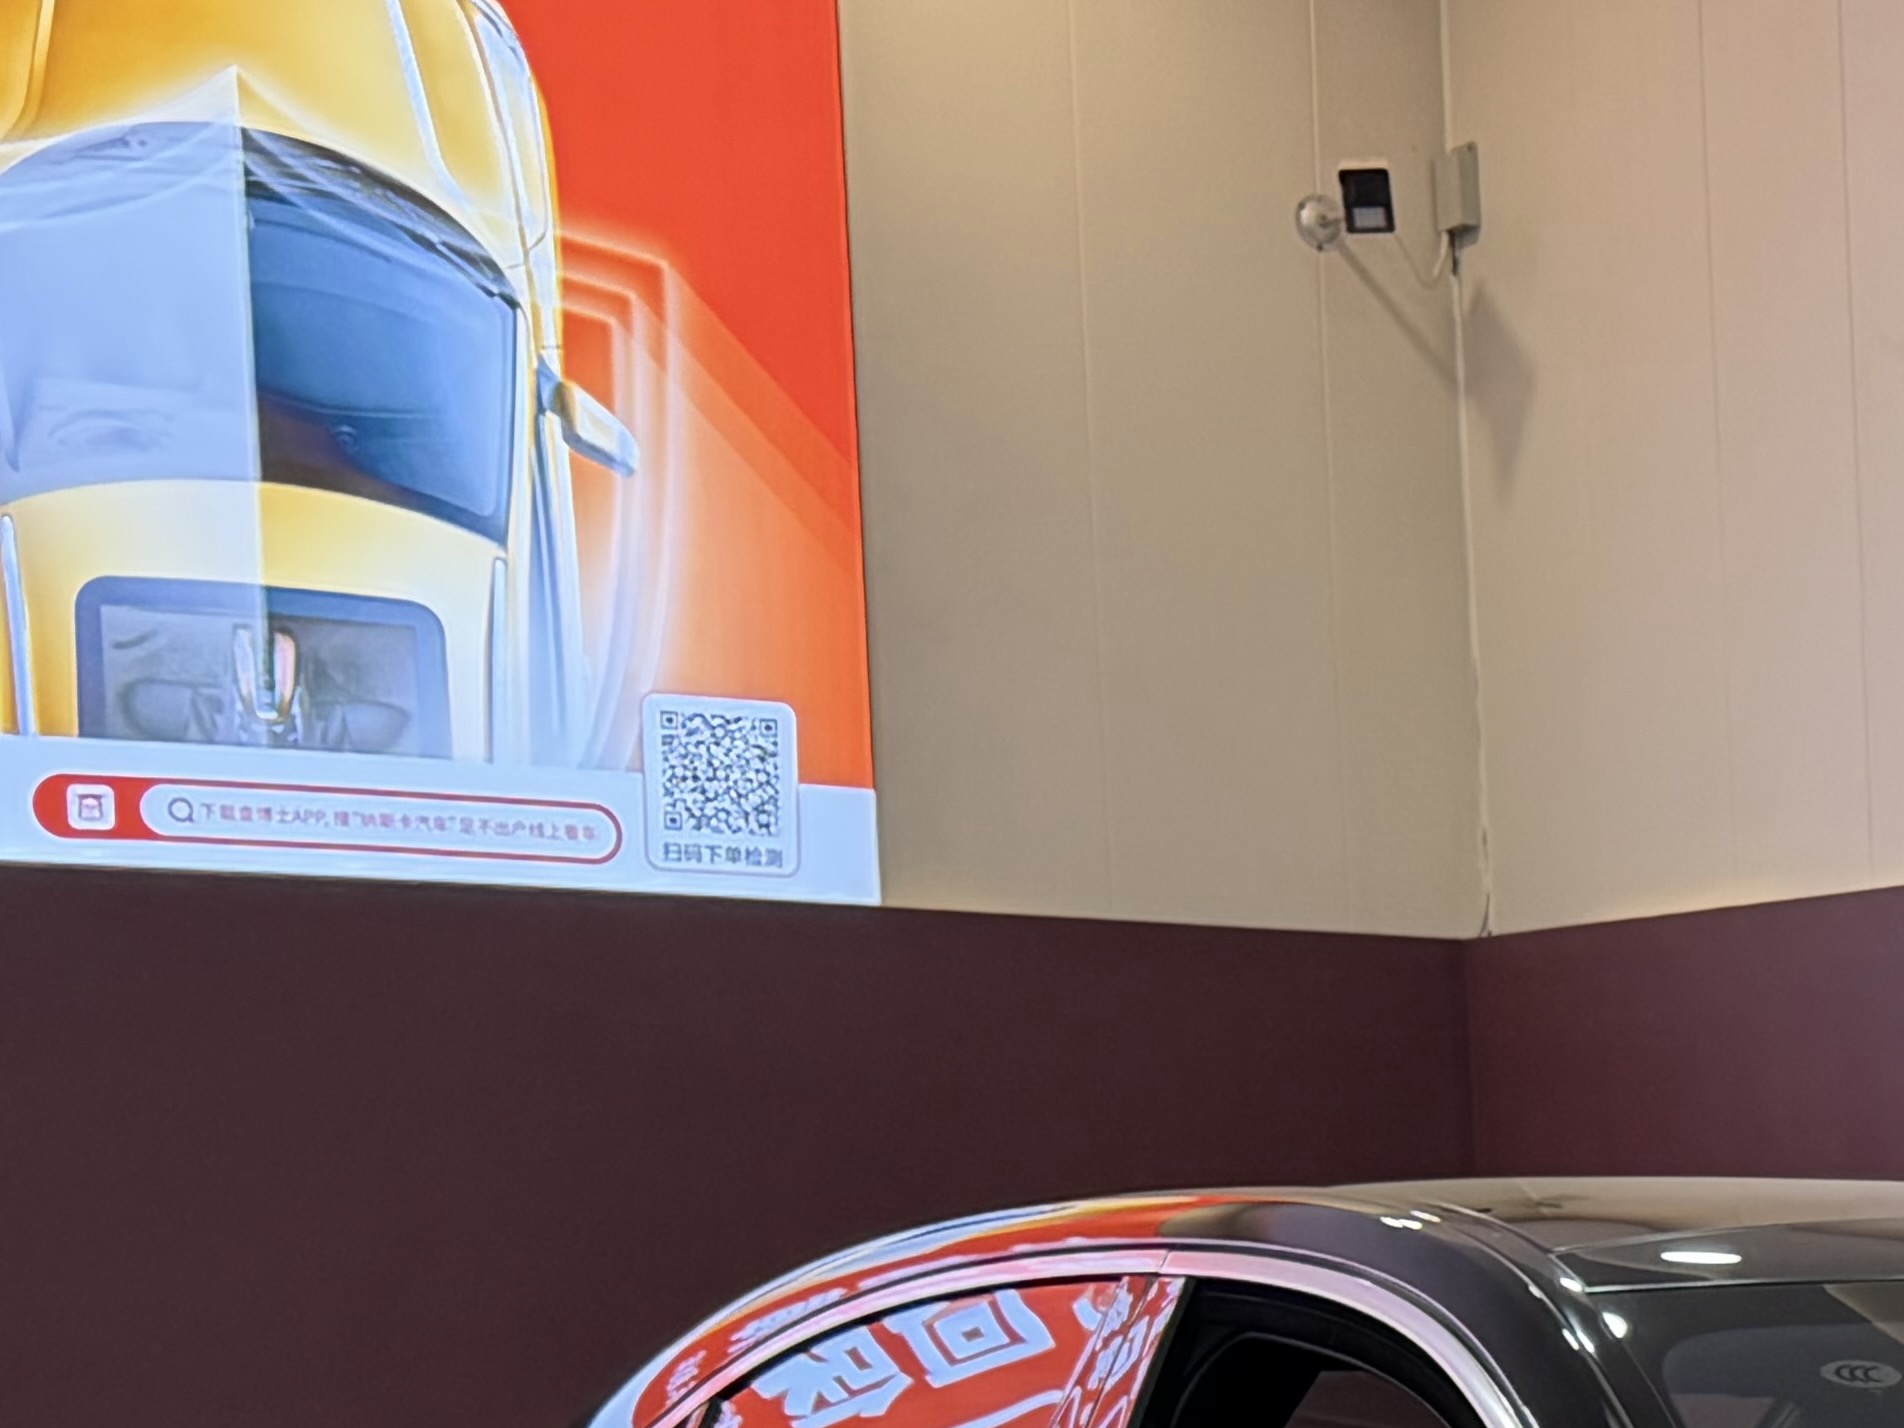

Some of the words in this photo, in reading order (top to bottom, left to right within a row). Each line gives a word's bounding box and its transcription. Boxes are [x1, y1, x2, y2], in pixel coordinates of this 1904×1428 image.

[663, 842, 783, 868] 扫码下单检测
